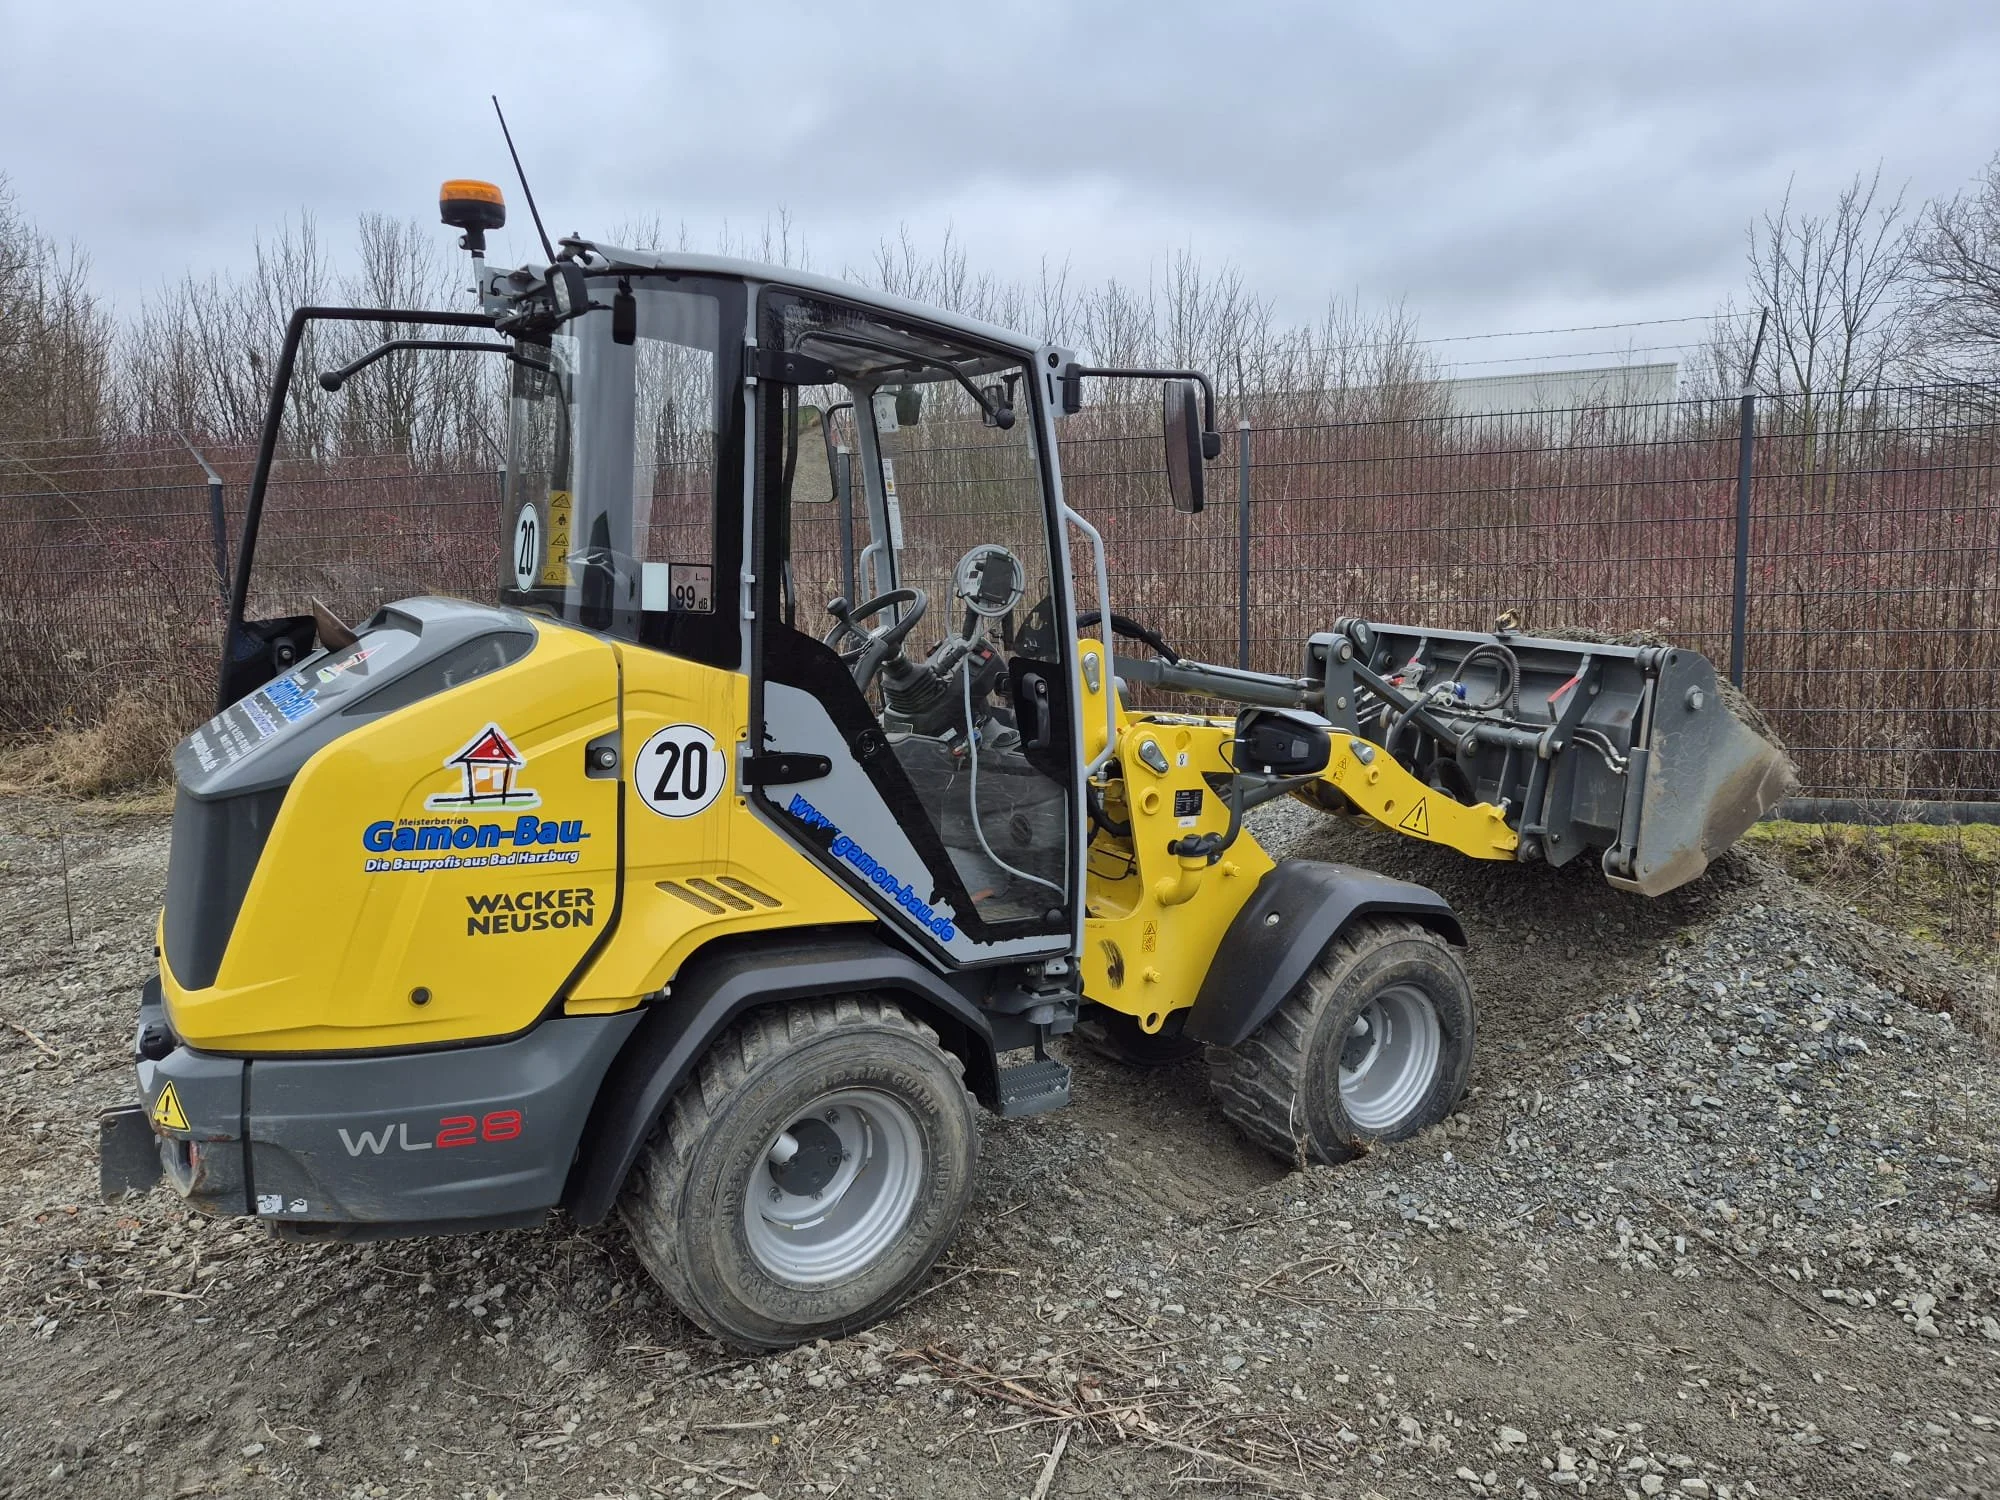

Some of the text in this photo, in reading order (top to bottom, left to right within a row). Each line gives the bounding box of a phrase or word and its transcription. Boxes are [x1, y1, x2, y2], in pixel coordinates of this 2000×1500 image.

[518, 519, 535, 577] 20
[676, 585, 696, 609] 99
[654, 741, 708, 801] 20
[362, 815, 583, 852] Gamon-Bau
[398, 817, 469, 826] Meisterbetrieb
[365, 849, 580, 873] Die Bauprofis aus Bad Harzburg
[466, 887, 596, 915] WACKER
[467, 908, 594, 937] NEUSON
